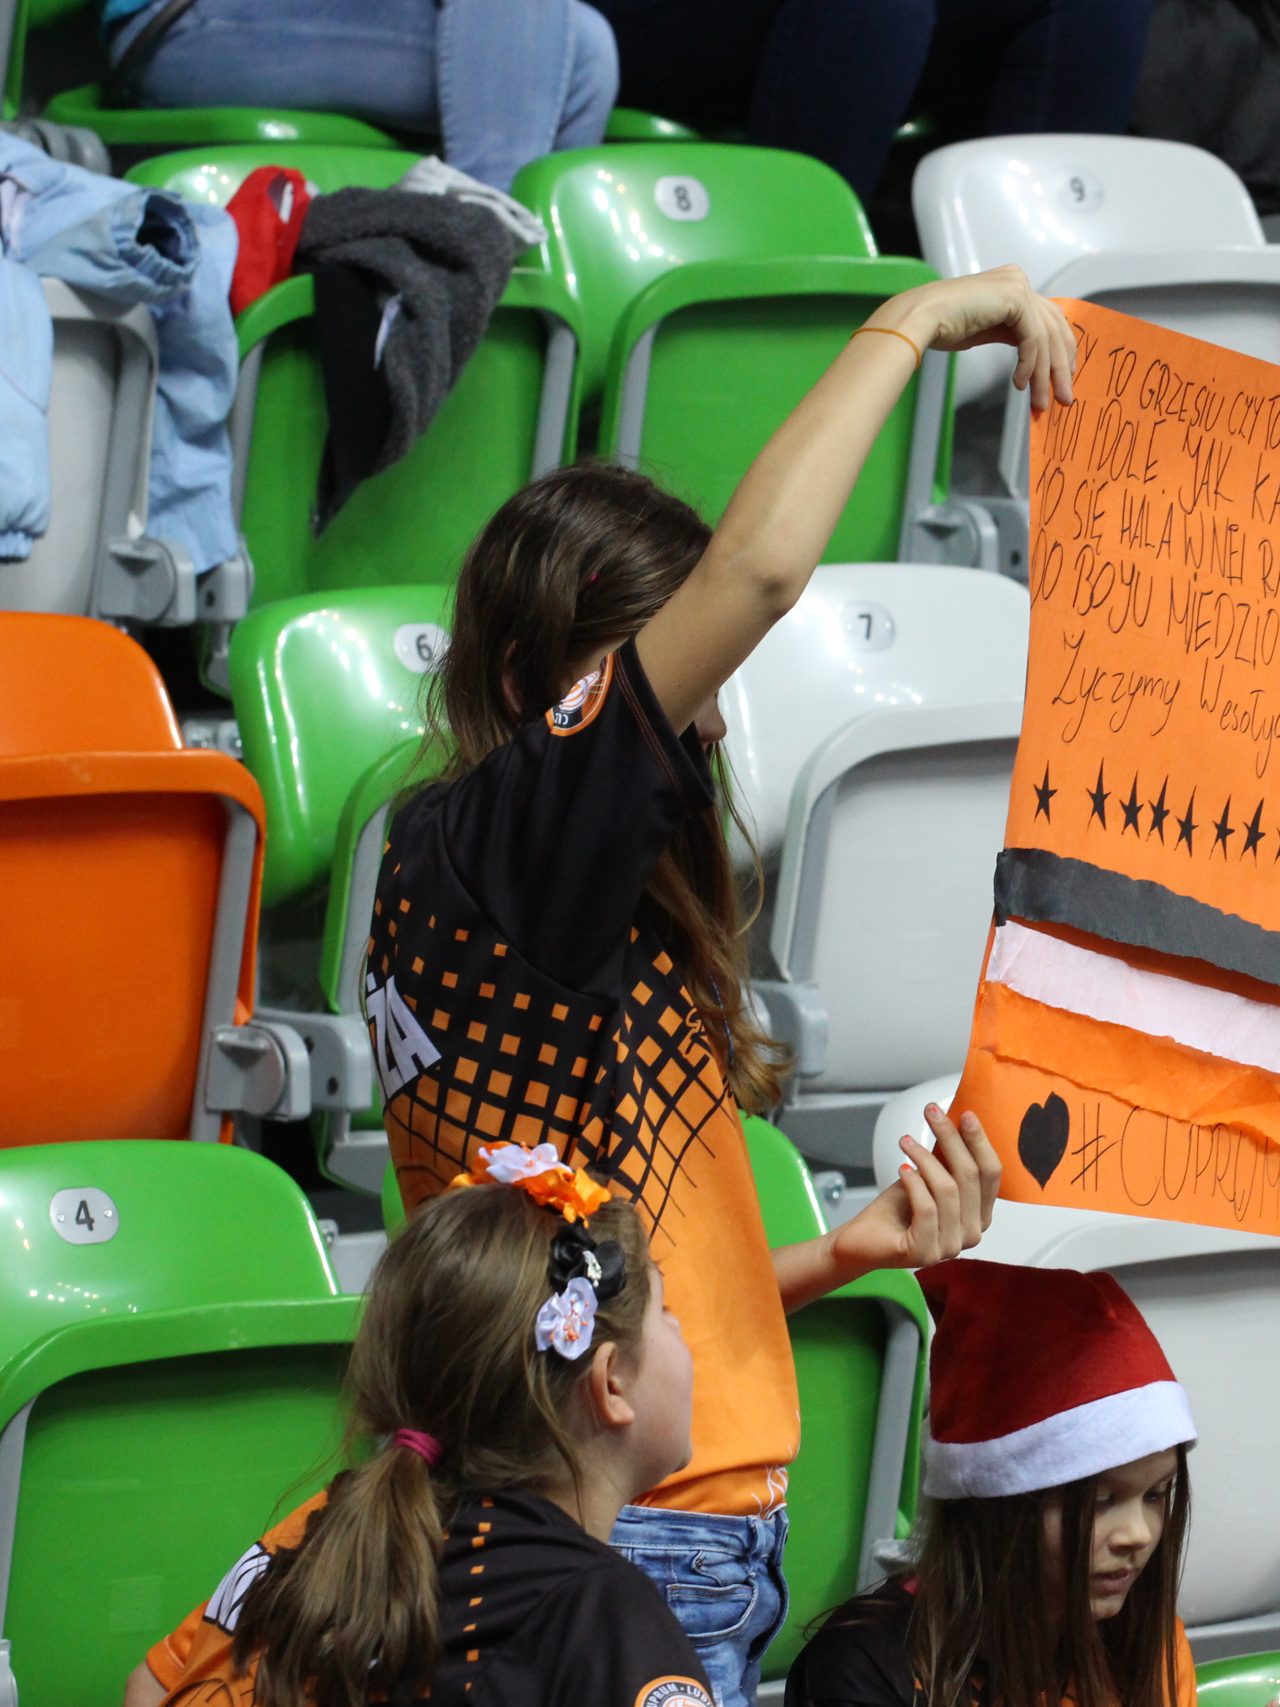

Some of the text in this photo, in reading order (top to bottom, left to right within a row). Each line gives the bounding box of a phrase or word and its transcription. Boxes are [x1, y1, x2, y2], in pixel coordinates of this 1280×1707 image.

[674, 186, 691, 212] 8
[1069, 177, 1085, 202] 9
[1072, 322, 1098, 385] ZY
[1107, 347, 1137, 397] TO
[1228, 391, 1265, 444] CZY
[1036, 457, 1065, 527] TO
[1119, 488, 1174, 559] HALA
[1183, 511, 1205, 569] W
[1031, 527, 1064, 609] DO
[858, 613, 872, 640] 7
[416, 633, 433, 661] 6
[1052, 629, 1181, 743] Życzymy
[75, 1200, 95, 1231] 4
